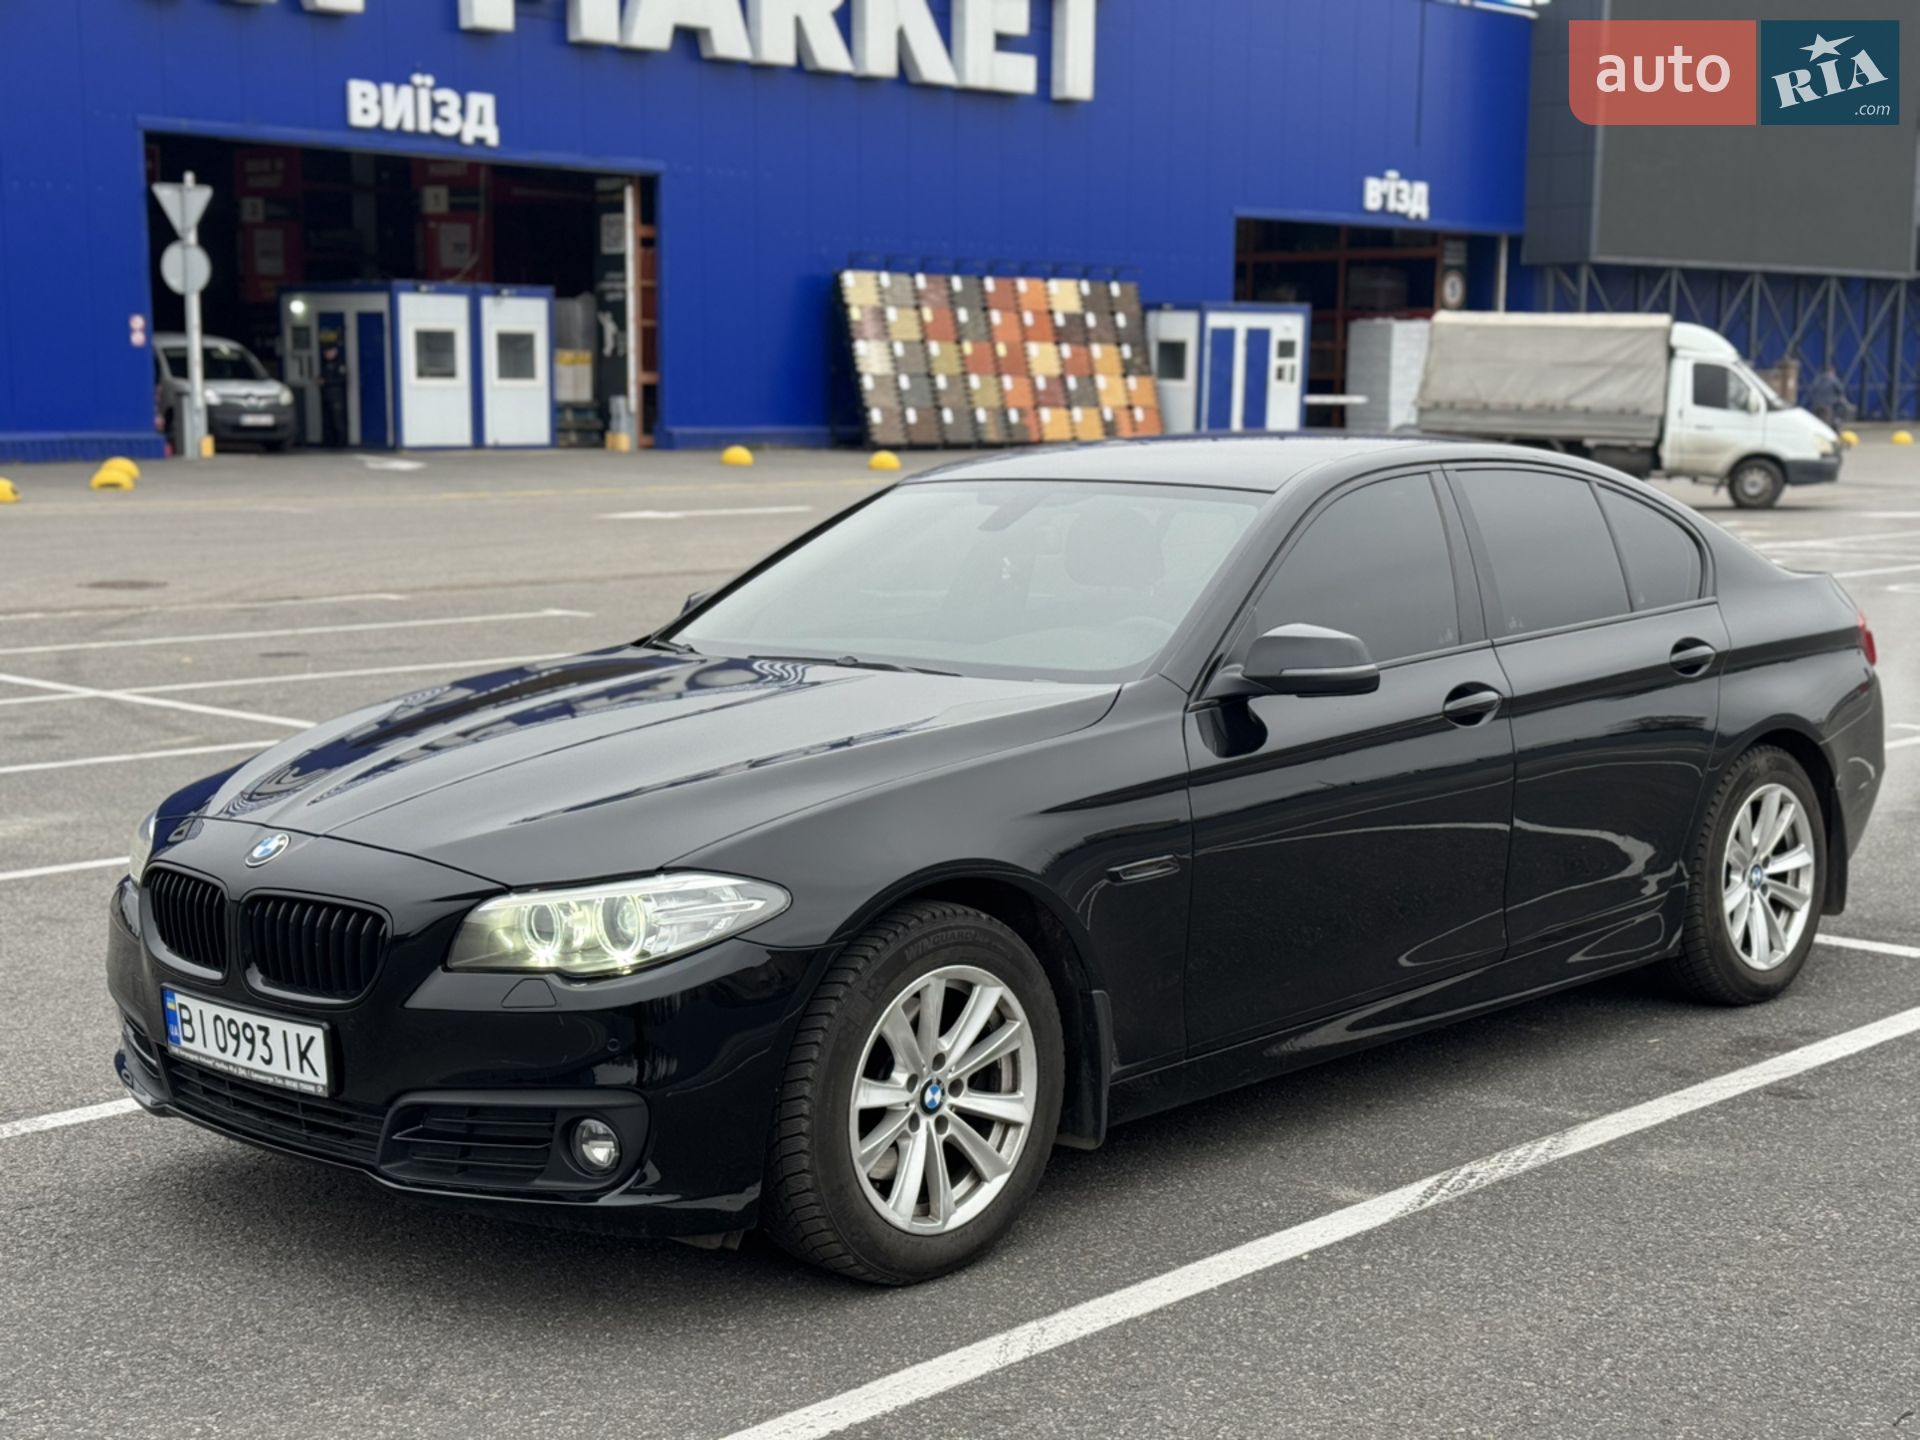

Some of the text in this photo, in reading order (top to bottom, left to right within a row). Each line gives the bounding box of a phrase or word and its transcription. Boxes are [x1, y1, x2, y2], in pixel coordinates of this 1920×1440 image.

[460, 0, 1096, 102] RKET
[346, 72, 500, 148] ВИЇЗД
[168, 1023, 180, 1037] UA
